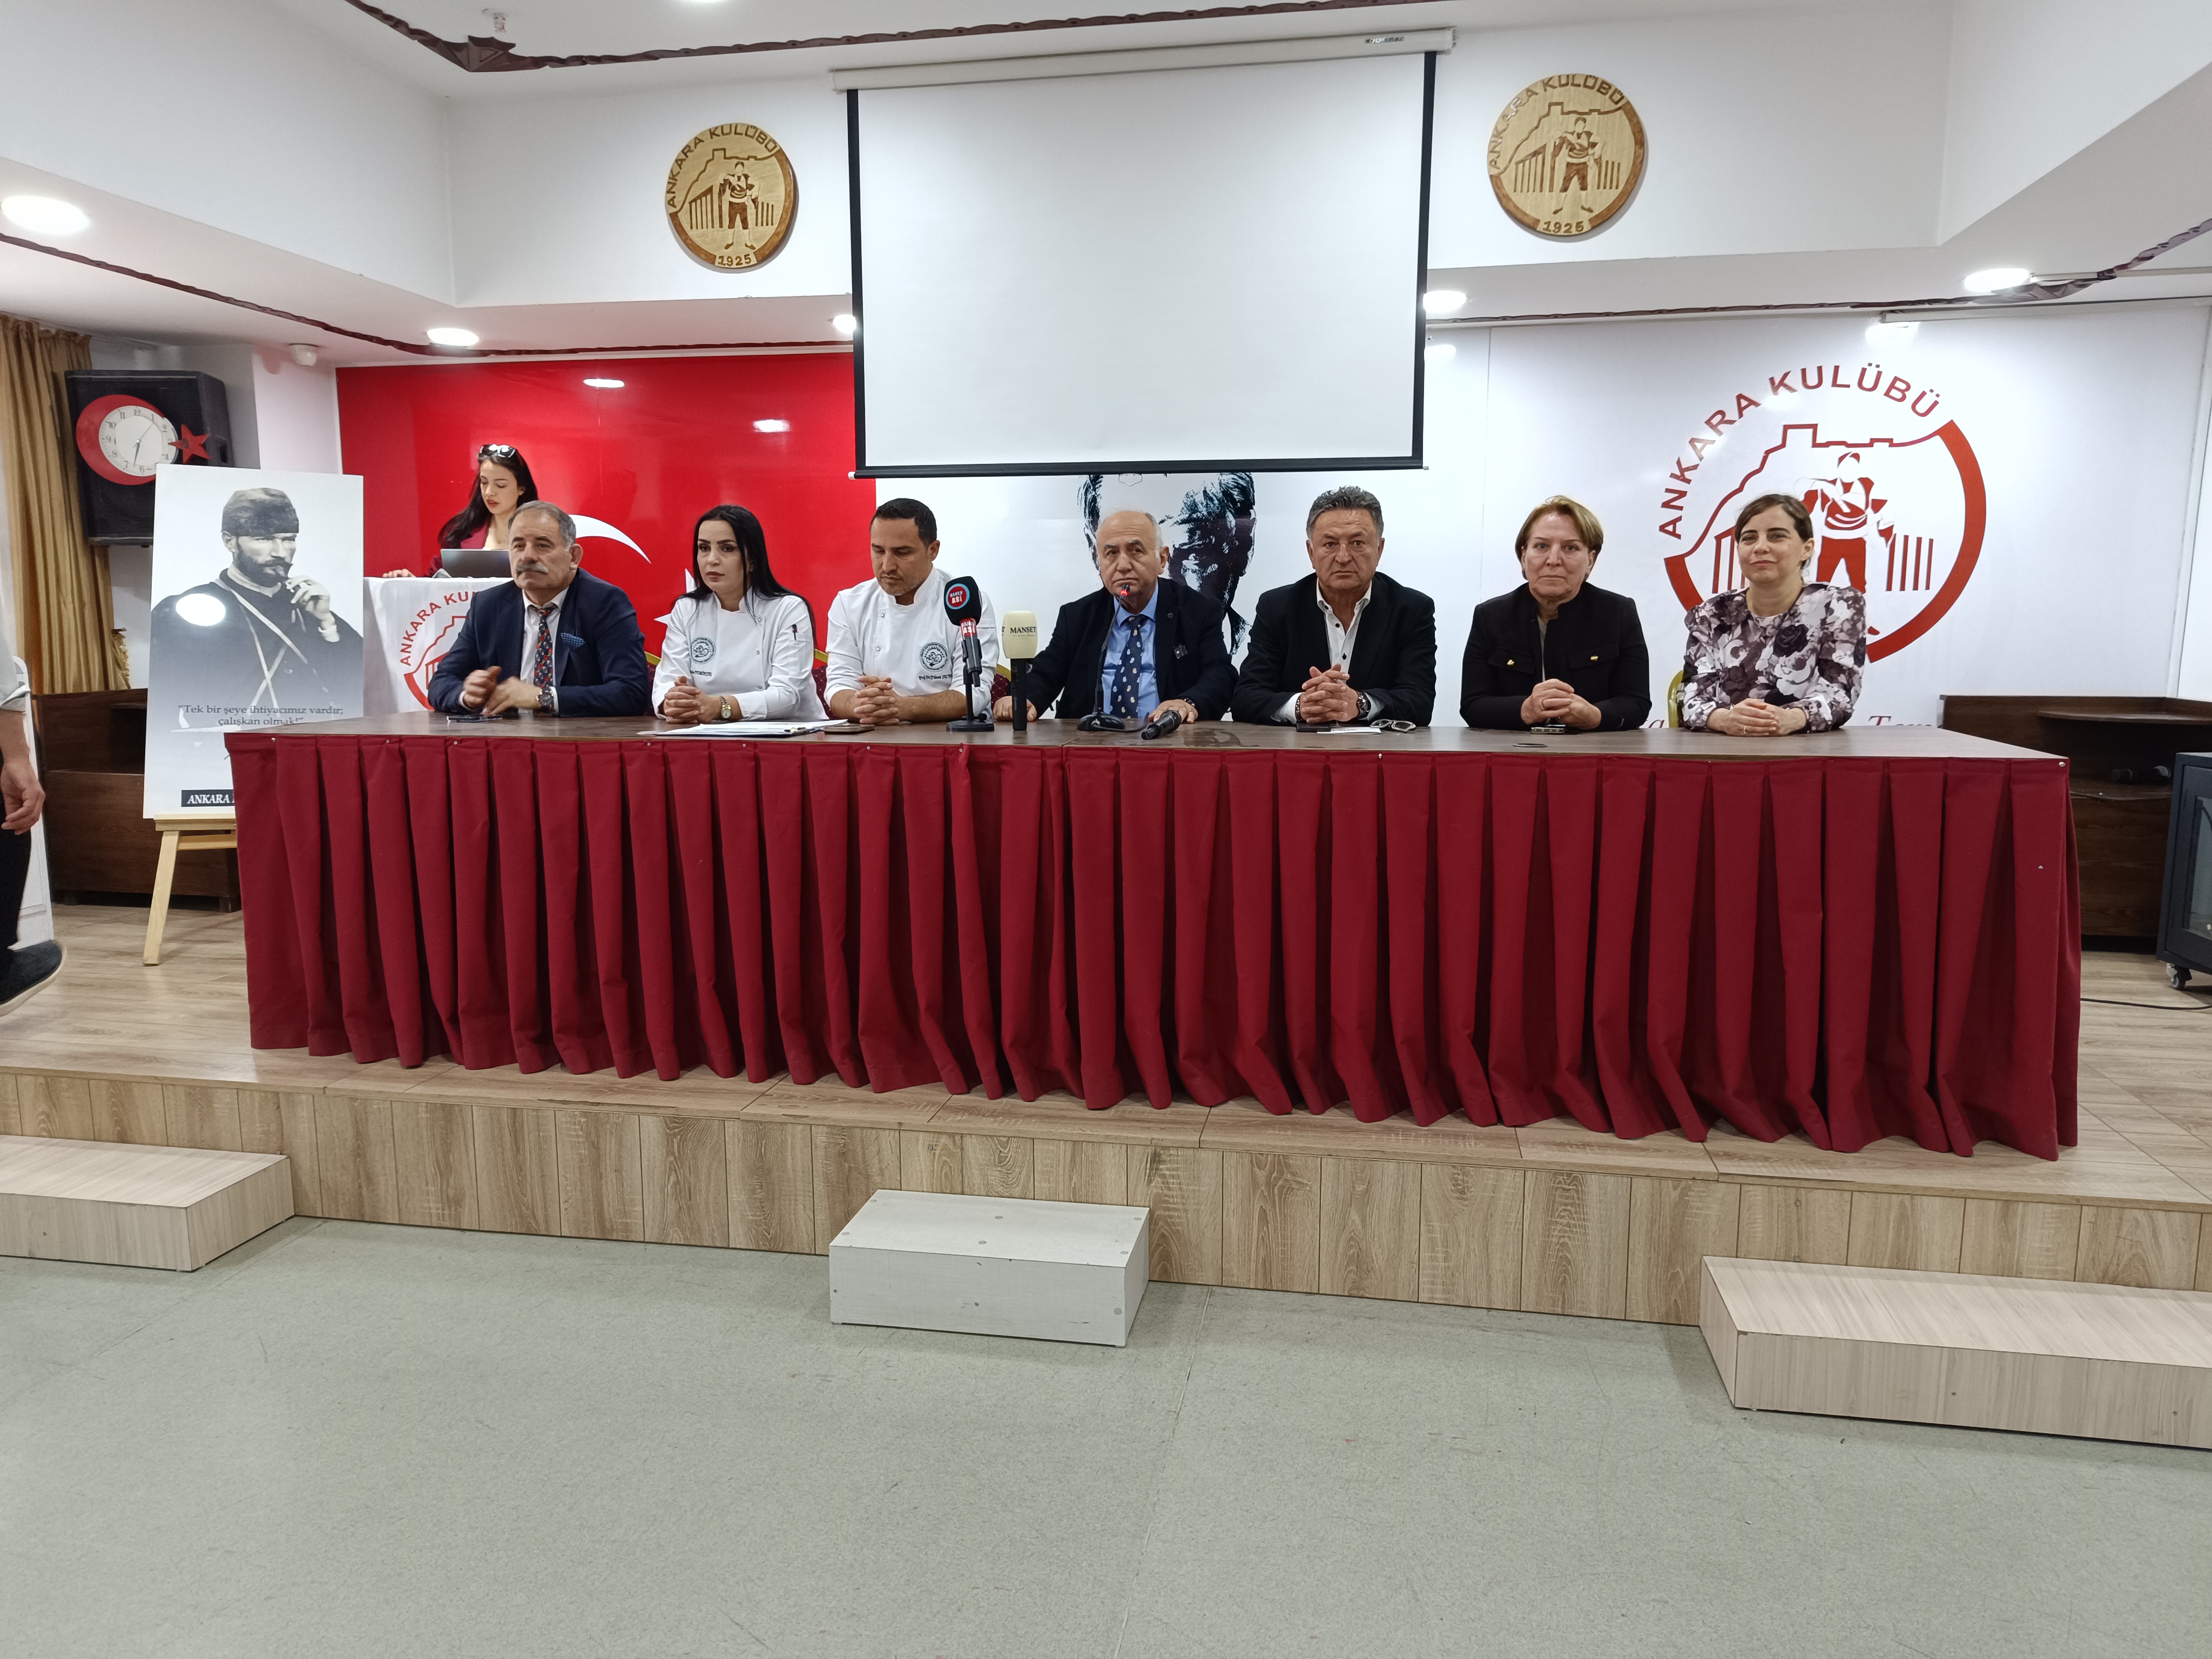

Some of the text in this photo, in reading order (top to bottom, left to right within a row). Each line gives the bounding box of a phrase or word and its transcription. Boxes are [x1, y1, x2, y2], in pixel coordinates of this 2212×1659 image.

[1488, 73, 1626, 170] ANKARA KULÜBÜ
[666, 123, 778, 209] ANKARA KULÜBÜ
[1542, 220, 1585, 234] 1925
[717, 253, 752, 266] 1925
[1659, 362, 1940, 540] ANKARA KULÜBÜ
[400, 602, 442, 666] ANKARA
[206, 705, 222, 714] bir
[224, 707, 247, 716] şeye
[249, 706, 307, 716] ihtiyacımız
[218, 717, 260, 726] çalışkan
[187, 794, 230, 804] ANKARA
